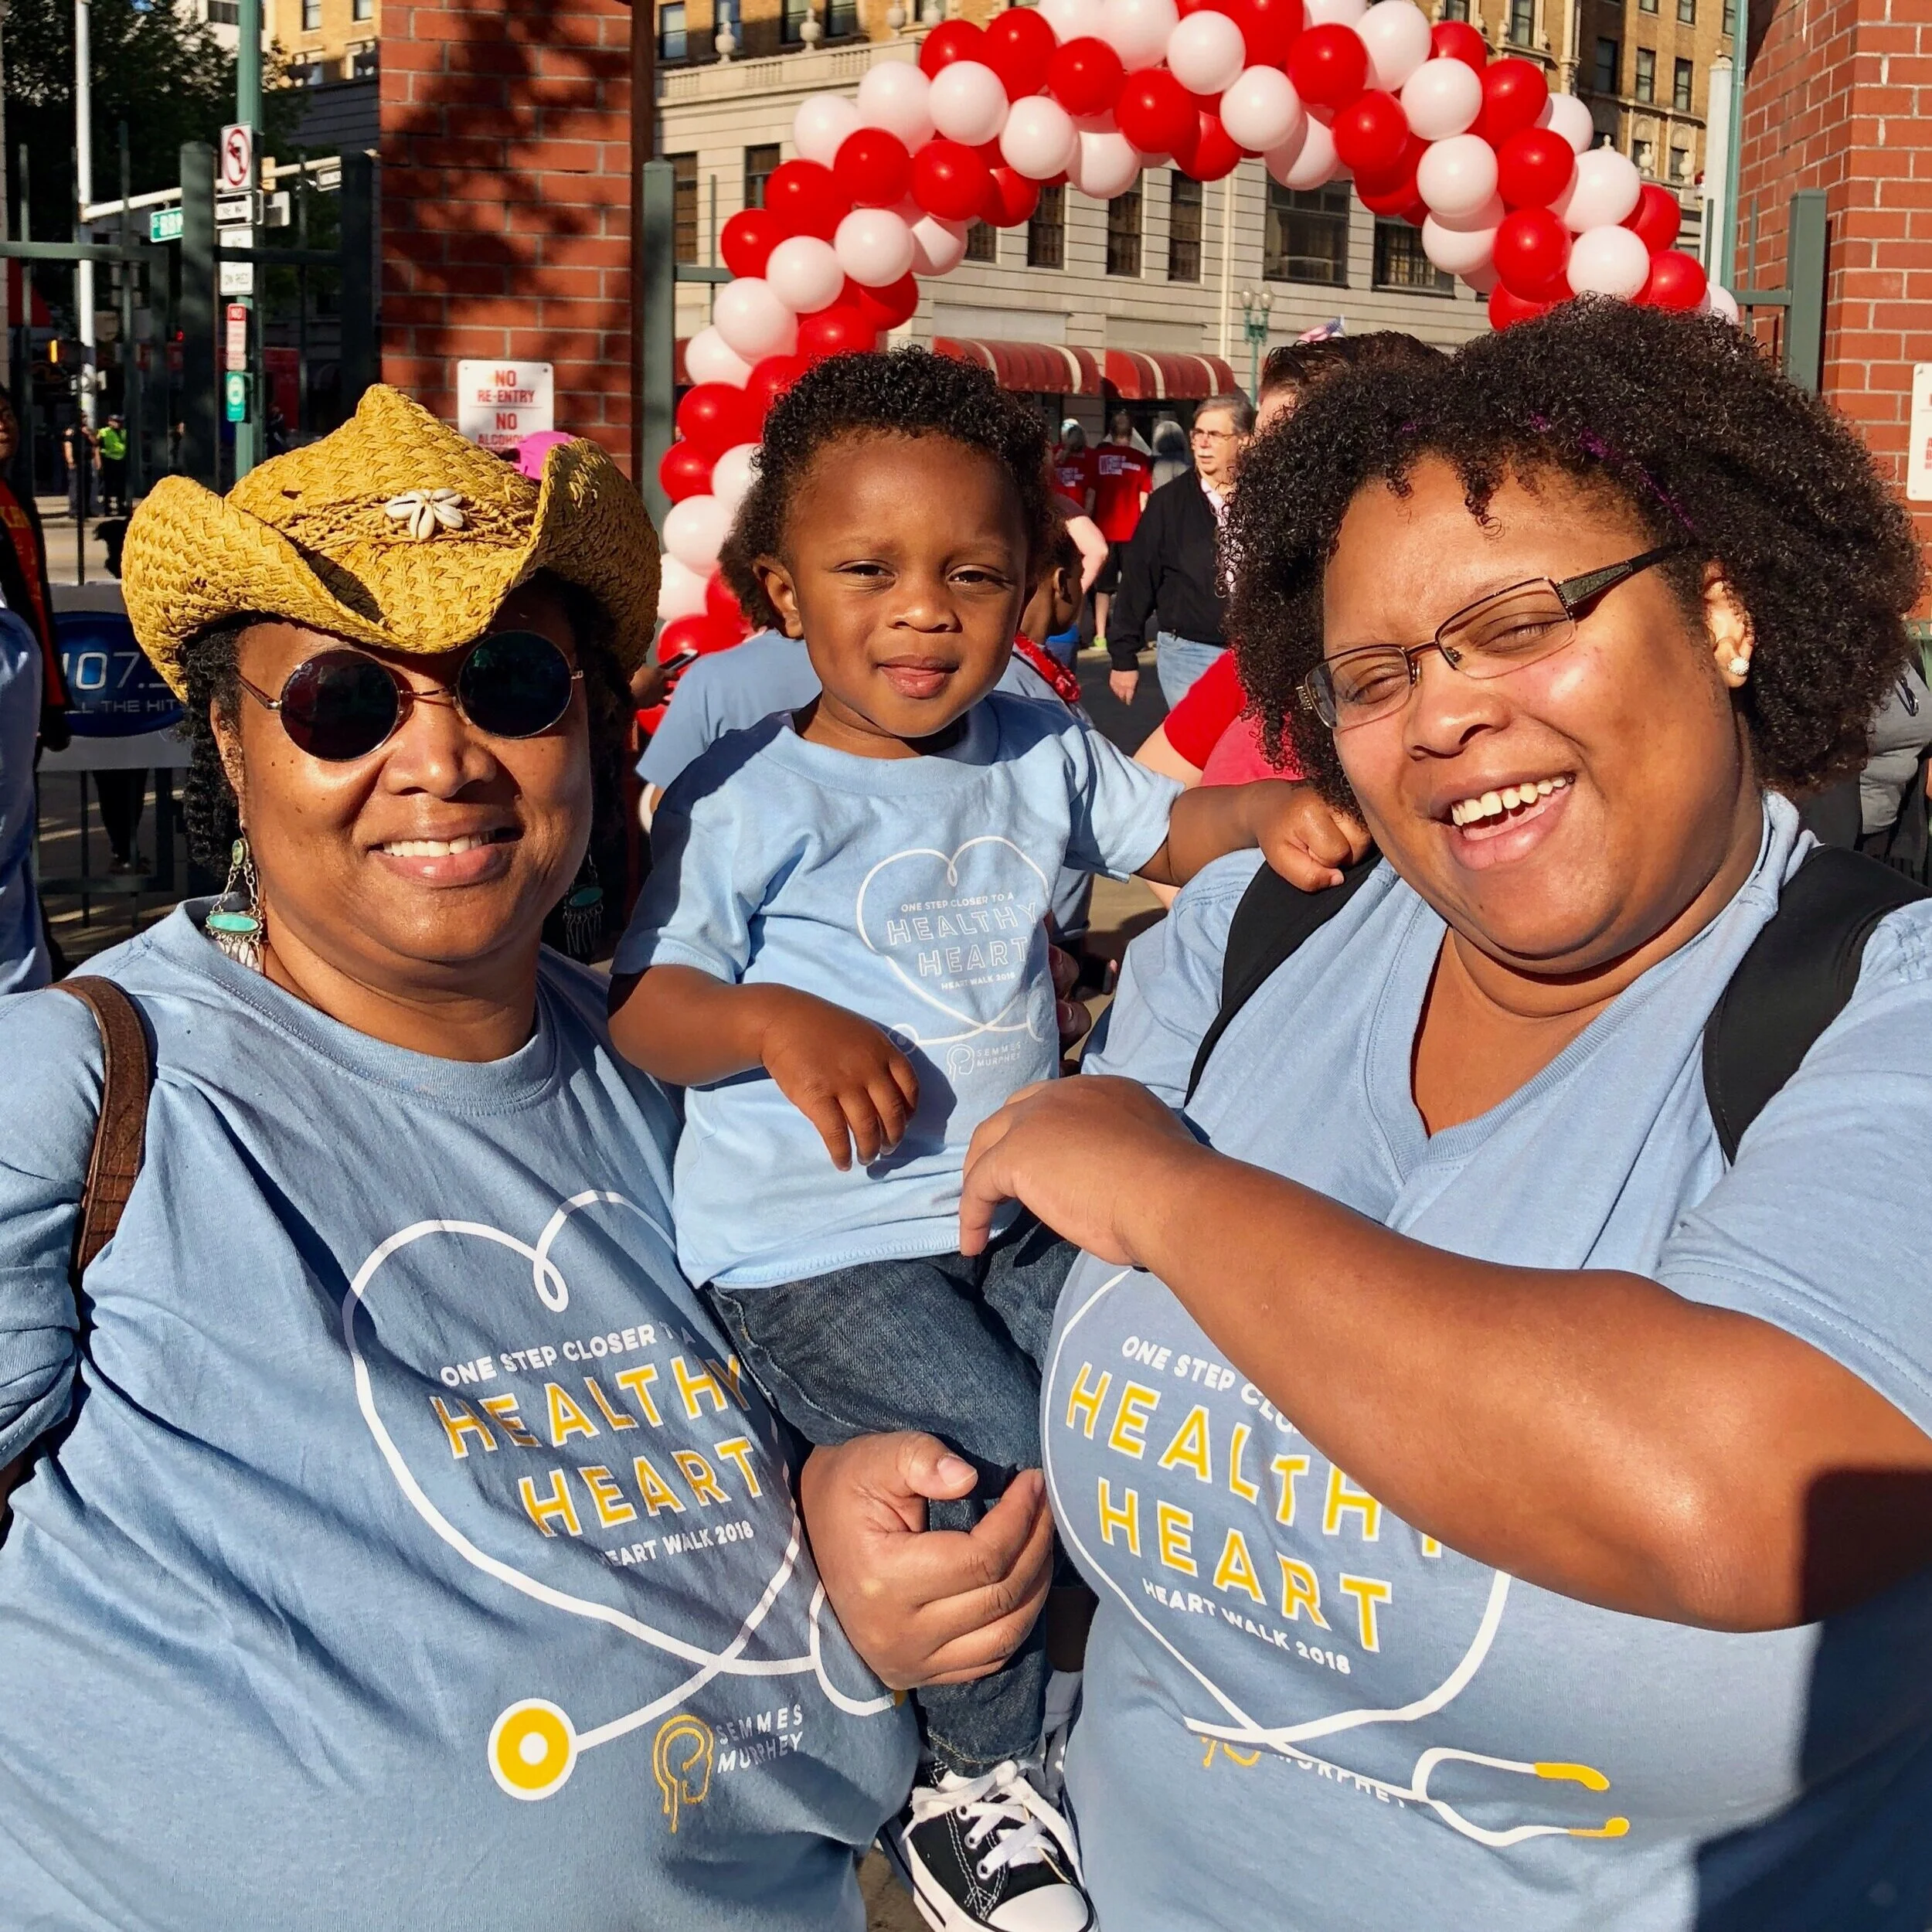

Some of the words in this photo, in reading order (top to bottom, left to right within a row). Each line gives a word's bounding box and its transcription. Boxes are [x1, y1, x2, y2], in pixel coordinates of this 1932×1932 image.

[477, 389, 536, 403] RE-ENTRY
[495, 369, 517, 387] NO
[495, 412, 518, 430] NO
[62, 651, 168, 690] 107.
[100, 699, 141, 713] THE
[147, 699, 177, 712] HIT
[901, 903, 923, 913] ONE
[924, 900, 948, 910] STEP
[950, 896, 988, 907] CLOSER
[991, 893, 1005, 903] TO
[1007, 892, 1015, 900] A
[886, 902, 1036, 947] HEALTHY
[918, 937, 1028, 978] HEART
[940, 979, 968, 990] HEART
[970, 975, 995, 985] WALK
[977, 1042, 1021, 1057] SEMMES
[440, 1355, 497, 1387] ONE
[499, 1345, 557, 1372] STEP
[563, 1323, 657, 1362] CLOSER
[1121, 1335, 1172, 1372] ONE
[1173, 1353, 1236, 1392] STEP
[429, 1353, 752, 1460] HEALTHY
[1066, 1361, 1443, 1559] HEALTH
[517, 1436, 763, 1538] HEART
[600, 1539, 657, 1567] EART
[662, 1528, 714, 1556] WALK
[715, 1520, 754, 1545] 2018
[1097, 1476, 1392, 1653] HEART
[1142, 1577, 1216, 1618] HEART
[1222, 1606, 1291, 1651] WALK
[1295, 1640, 1351, 1675] 2018
[716, 1703, 804, 1746] SEMMES
[717, 1731, 804, 1774] MURPHEY
